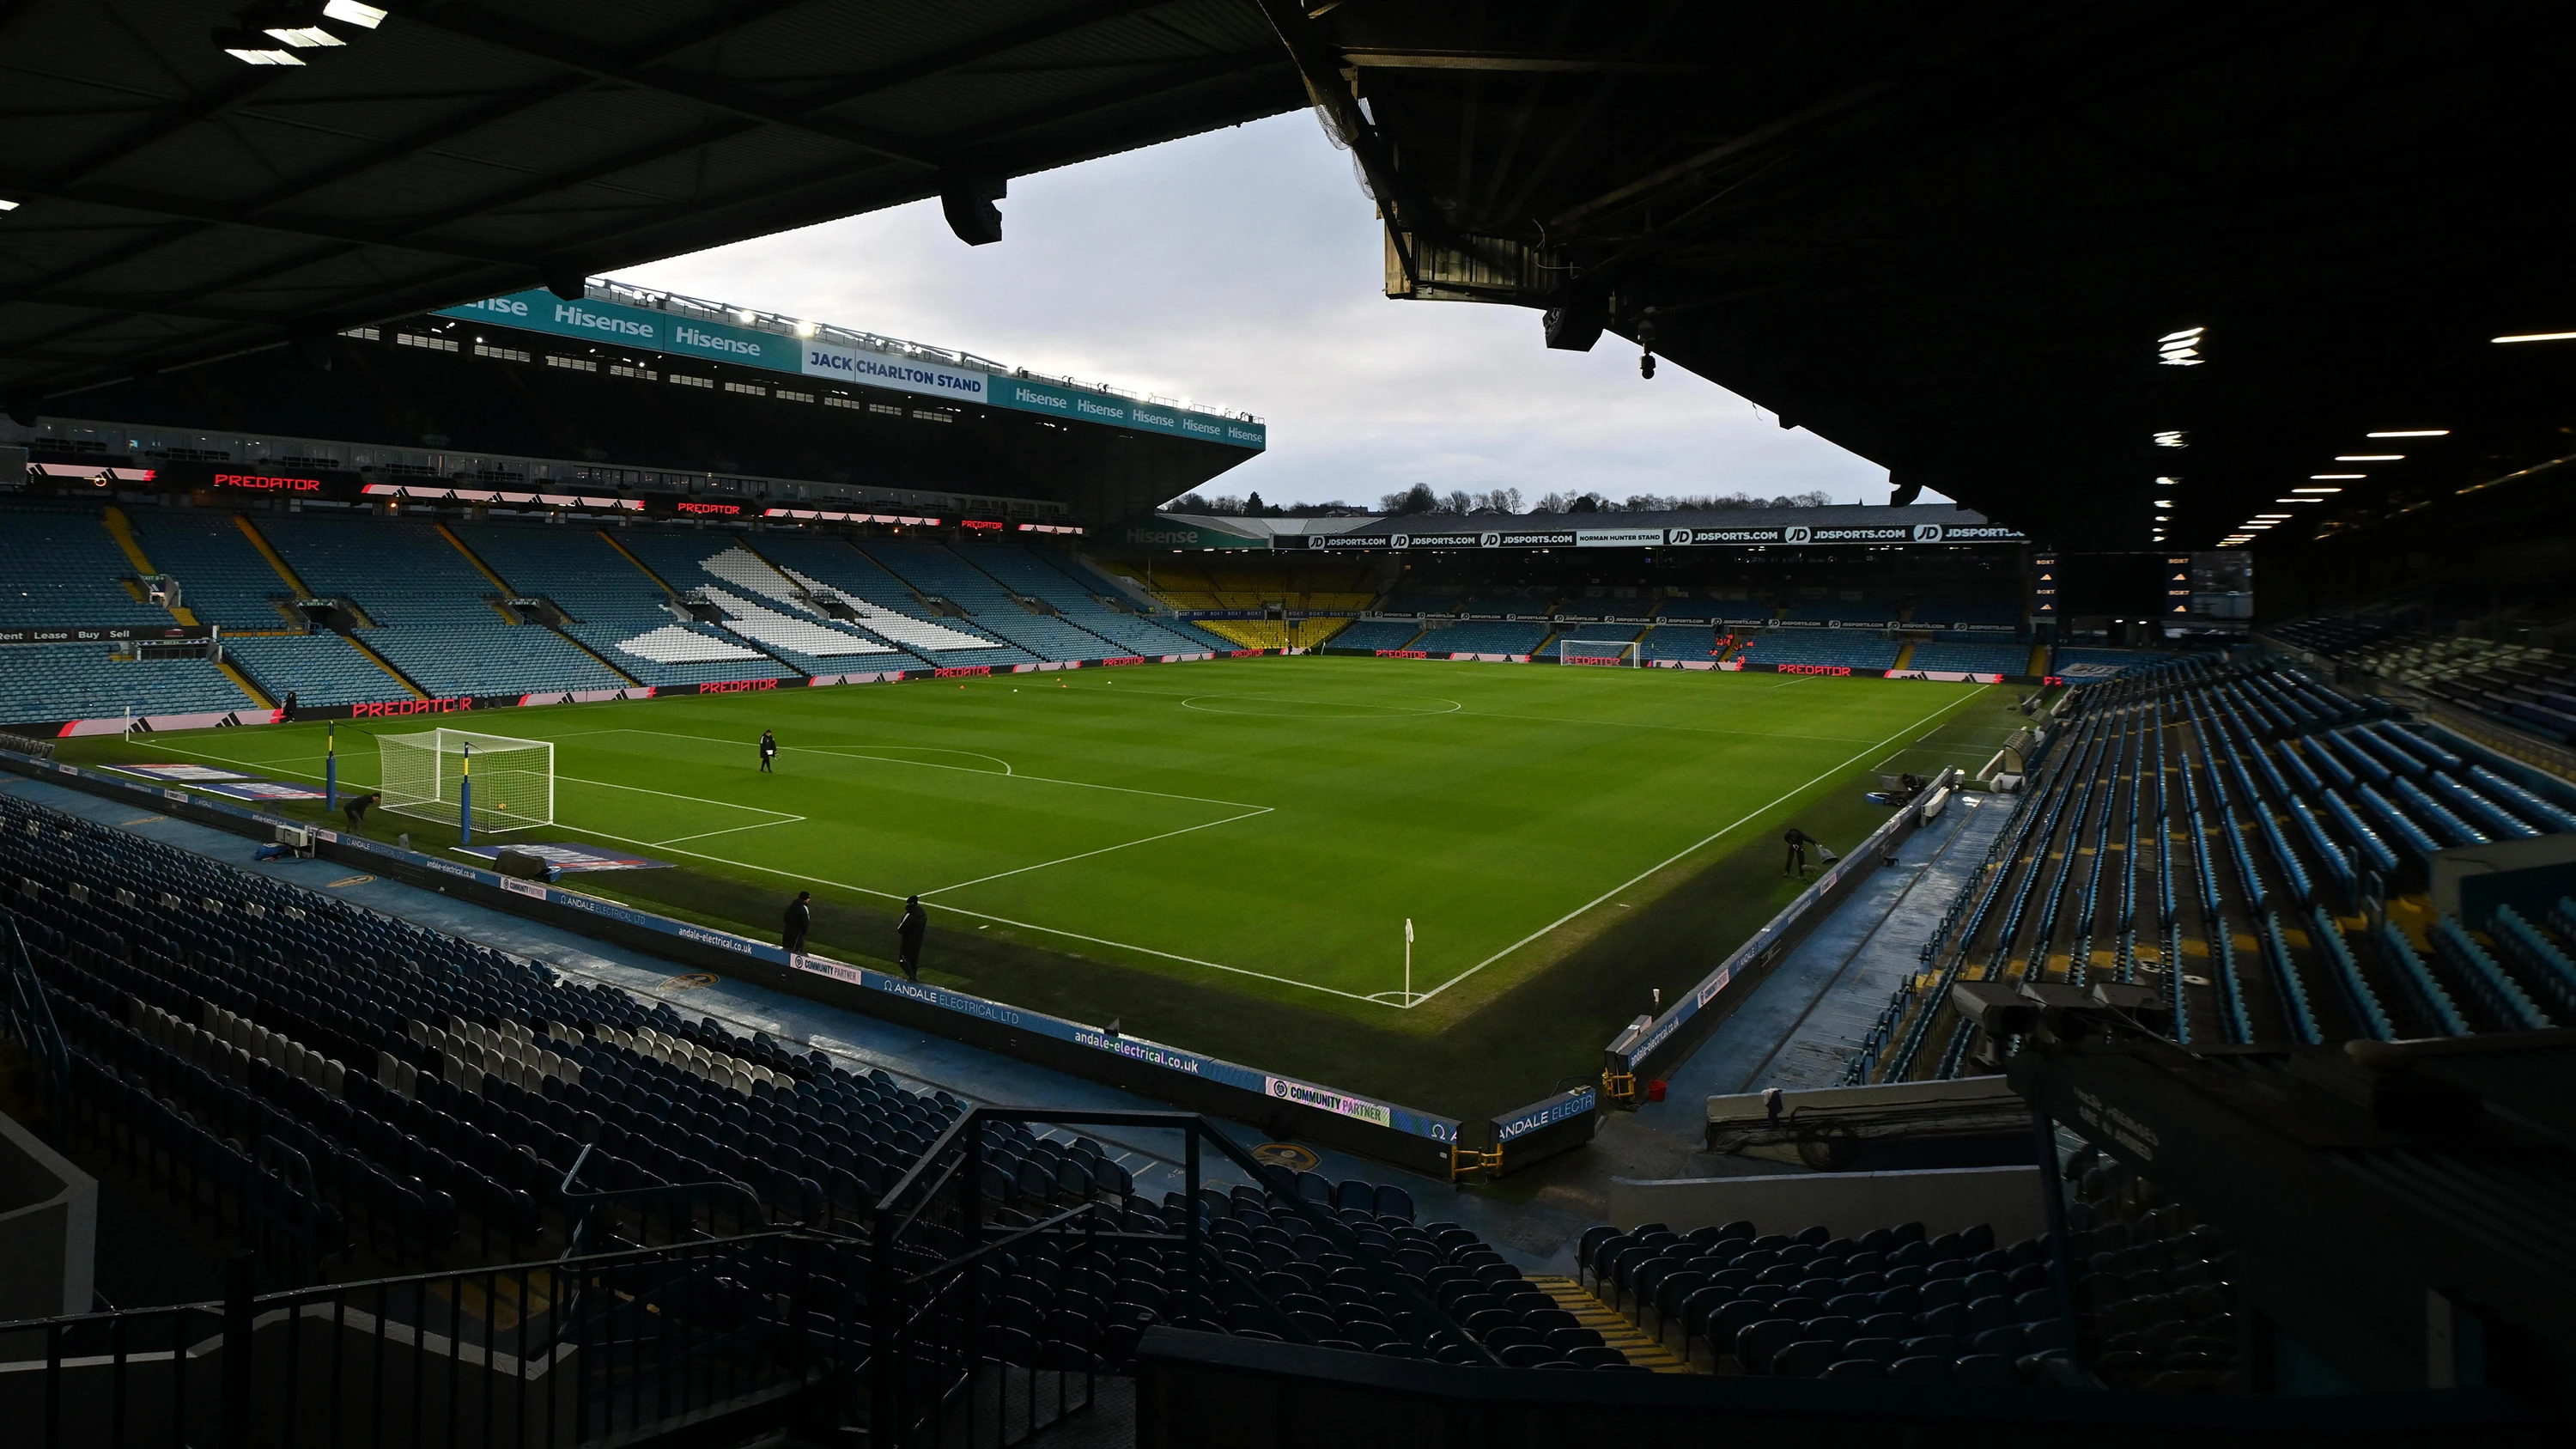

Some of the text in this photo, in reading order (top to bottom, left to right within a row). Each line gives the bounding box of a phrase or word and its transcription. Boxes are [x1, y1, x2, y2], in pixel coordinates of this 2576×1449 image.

[555, 304, 654, 338] Hisense
[676, 326, 761, 356] Hisense
[811, 351, 981, 393] JACK CHARLTON STAND
[1015, 387, 1263, 442] Hisense Hisense Hisense Hisense Hisense
[215, 474, 1003, 529] PREDATOR PREDATOR PREDATOR
[1126, 528, 1198, 544] Hisense
[1503, 535, 1572, 544] JDSPORTS.COM
[1695, 532, 1777, 541] JDSPORTS.COM
[1814, 529, 1905, 539] JDSPORTS.COM
[33, 631, 68, 640] Lease
[78, 630, 100, 640] Buy
[110, 630, 130, 638] Sell
[352, 697, 472, 718] PREDATOR
[700, 679, 778, 694] PREDATOR
[935, 666, 991, 678] PREDATOR
[1103, 656, 1145, 667] PREDATOR
[1231, 648, 1265, 658] PREDATOR
[1778, 664, 1851, 676] PREDATOR
[351, 838, 370, 850] ANDALE
[427, 861, 477, 880] andale-electrical.co.uk
[509, 881, 529, 892] COMMUNITY
[567, 895, 595, 911] ANDALE
[596, 905, 632, 922] ELECTRICAL
[634, 914, 646, 925] LTD
[678, 928, 752, 954] andale-electrical.co.uk
[805, 959, 834, 976] COMMUNITY
[834, 968, 856, 981] PARTNER
[894, 983, 937, 1002] ANDALE
[939, 995, 998, 1020] ELECTRICAL
[1001, 1011, 1019, 1024] LTD
[1074, 1032, 1199, 1074] andale-electrical.co.uk
[1290, 1087, 1341, 1111] COMMUNITY
[1342, 1100, 1381, 1121] PARTNER
[1631, 1015, 1680, 1067] andale-electrical.co.uk
